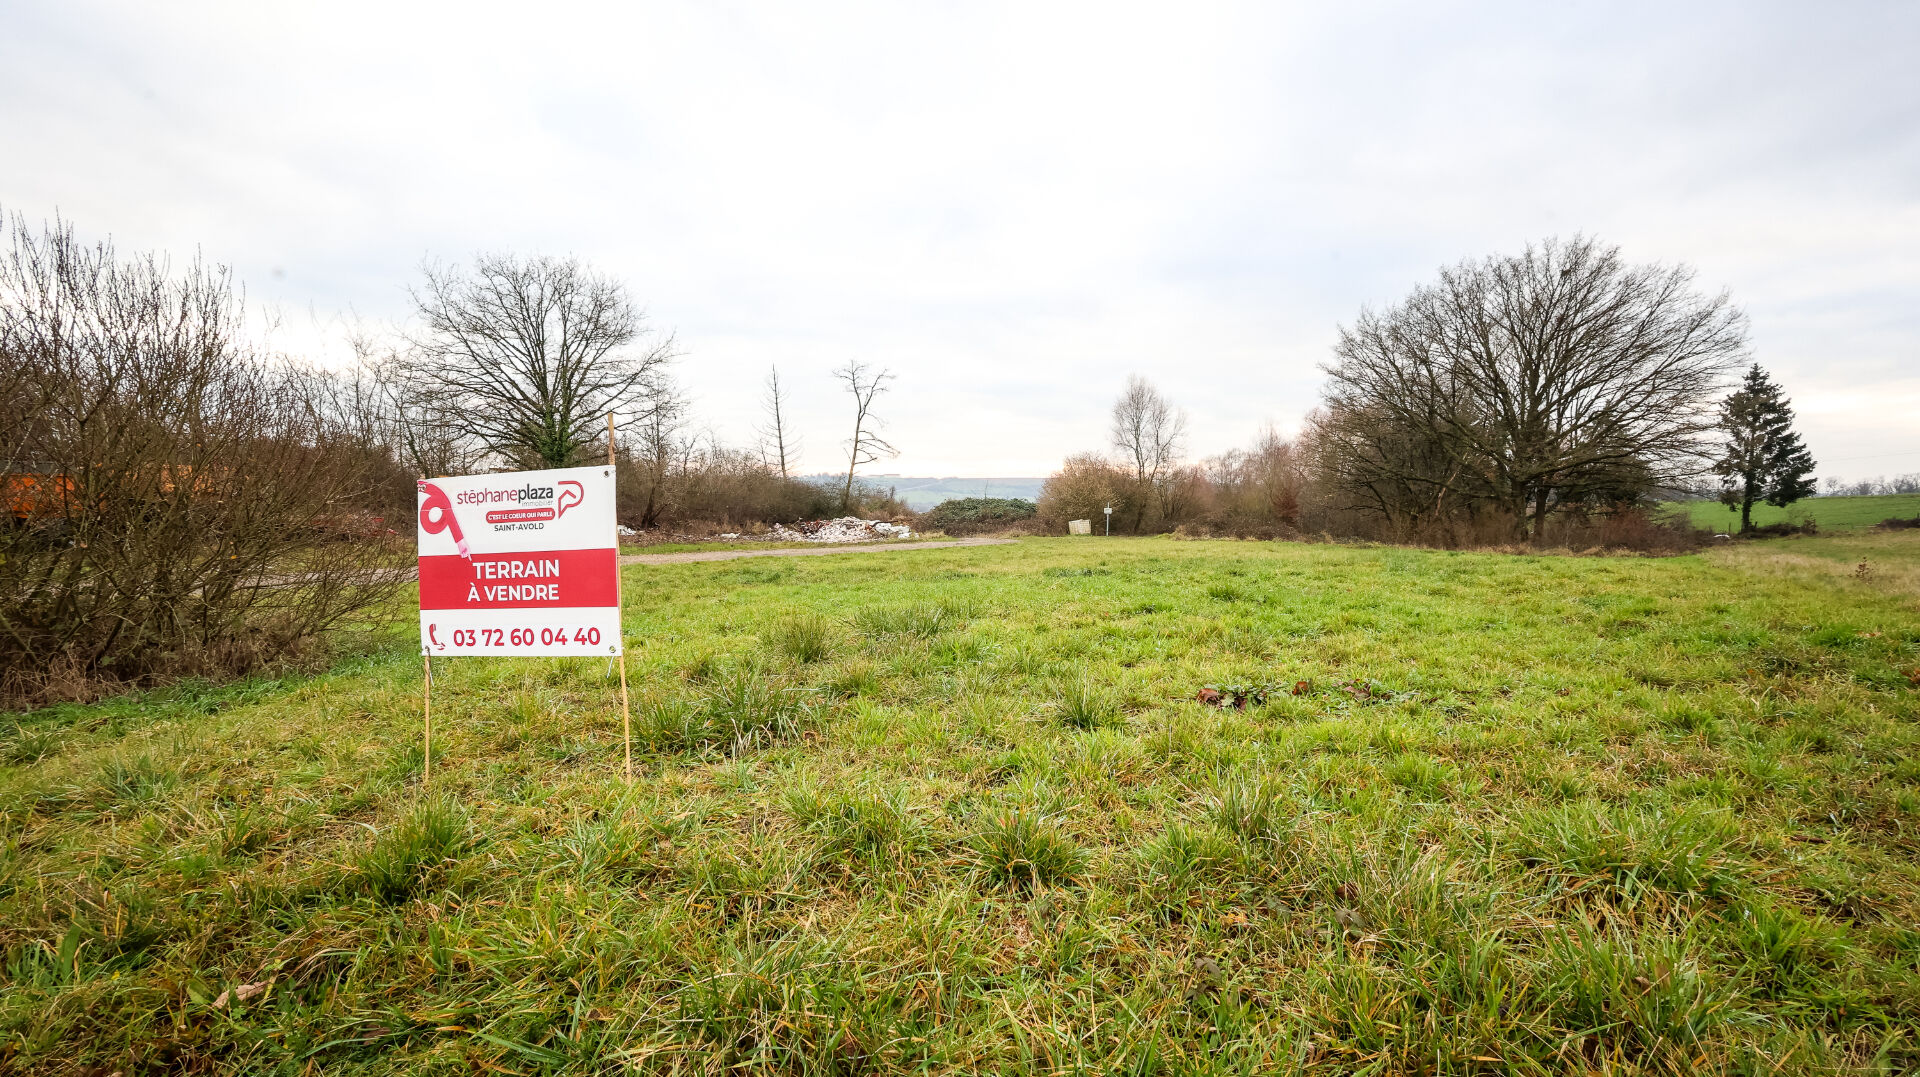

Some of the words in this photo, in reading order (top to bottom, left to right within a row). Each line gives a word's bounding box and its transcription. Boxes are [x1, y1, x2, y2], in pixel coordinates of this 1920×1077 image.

[521, 499, 553, 507] immobilier
[494, 522, 544, 532] SAINT-AVOLD
[472, 559, 560, 580] TERRAIN
[467, 582, 481, 602] À
[483, 583, 560, 602] VENDRE
[453, 629, 476, 647] 03
[481, 628, 504, 647] 72
[510, 628, 535, 646] 60
[541, 627, 568, 646] 04
[573, 626, 601, 646] 40
